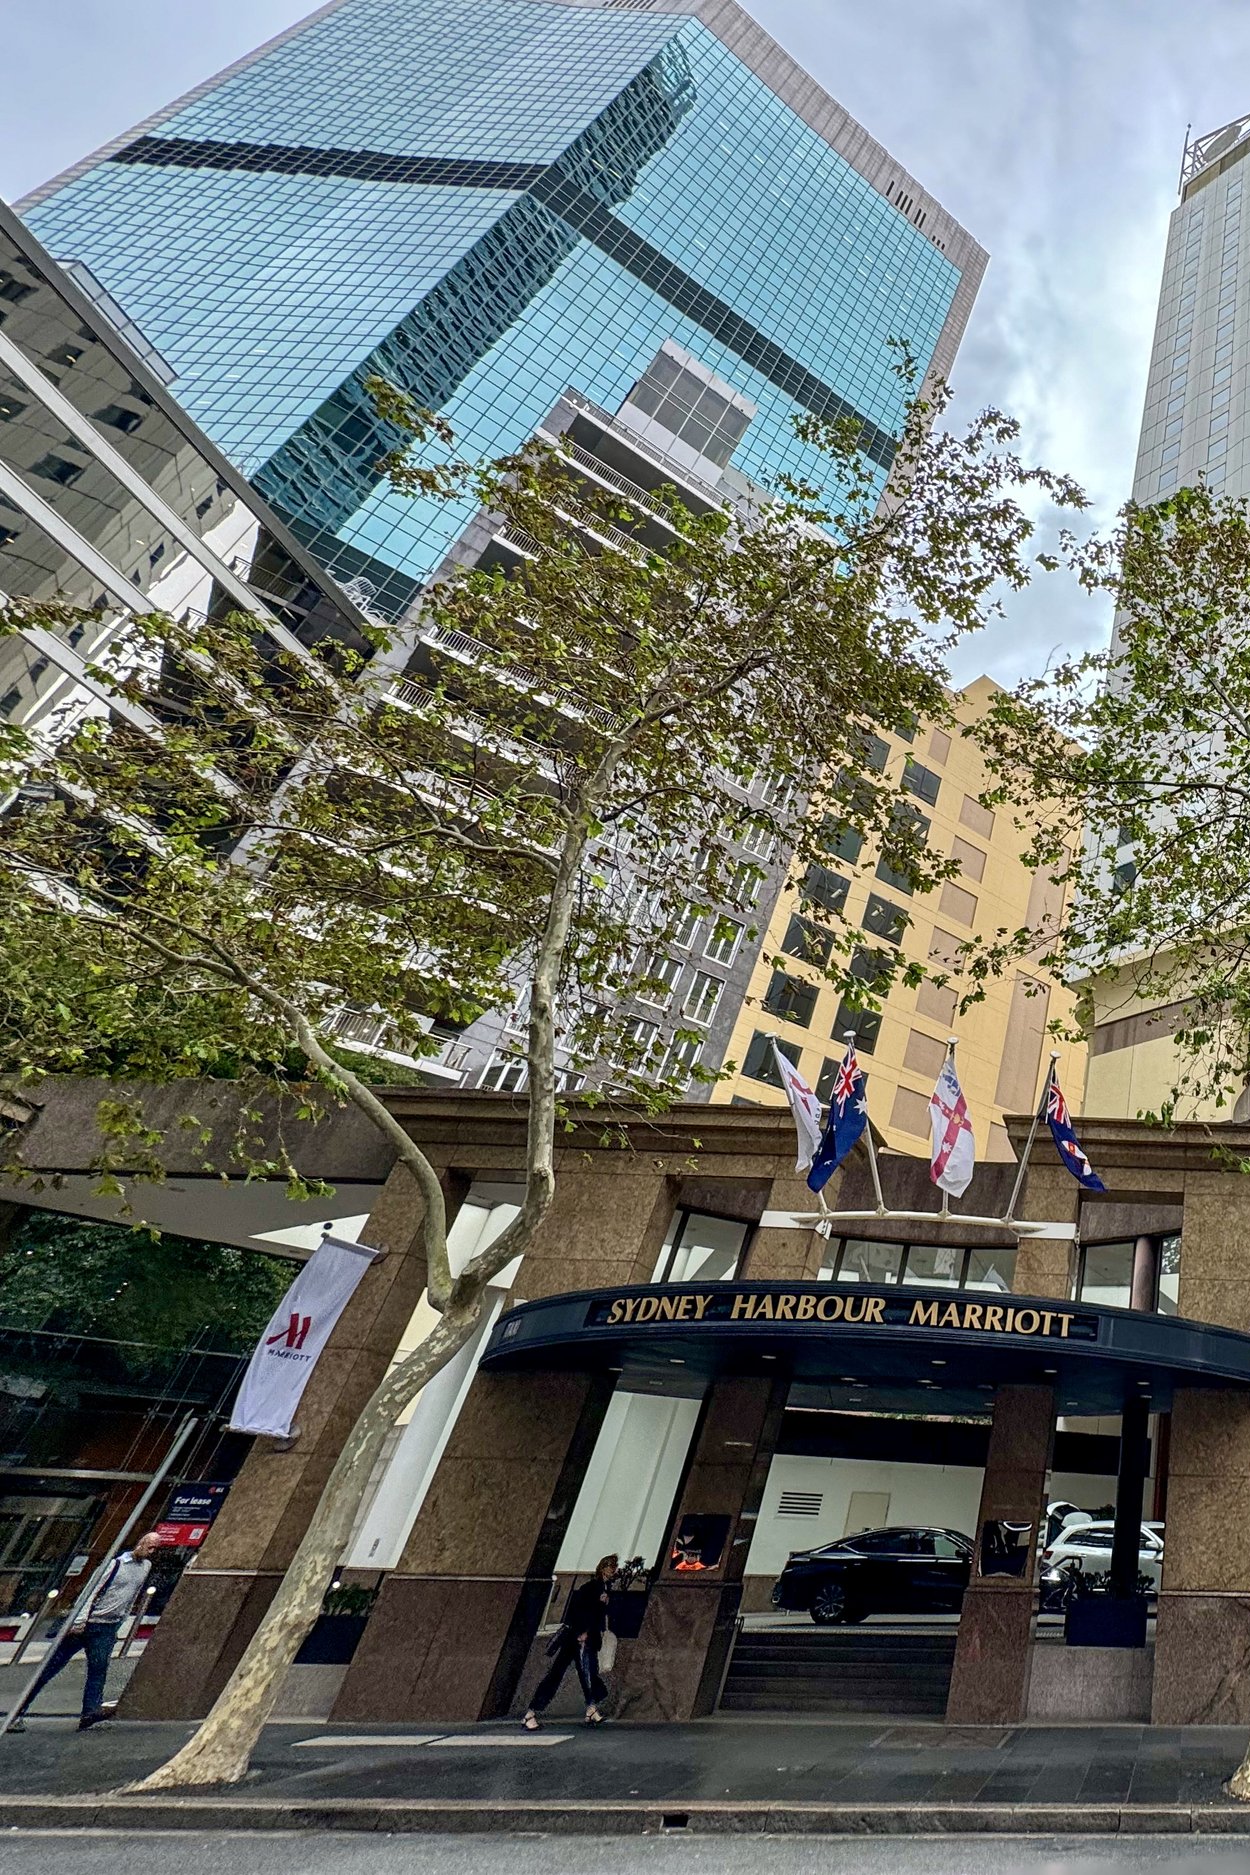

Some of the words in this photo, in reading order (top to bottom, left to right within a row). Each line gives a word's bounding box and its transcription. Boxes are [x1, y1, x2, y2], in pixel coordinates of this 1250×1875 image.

[606, 1294, 713, 1325] SYDNEY
[730, 1294, 886, 1323] HARBOUR
[909, 1300, 1075, 1338] MARRIOTT
[267, 1349, 311, 1361] MARRIOTT
[174, 1496, 190, 1505] For
[189, 1496, 212, 1505] lease
